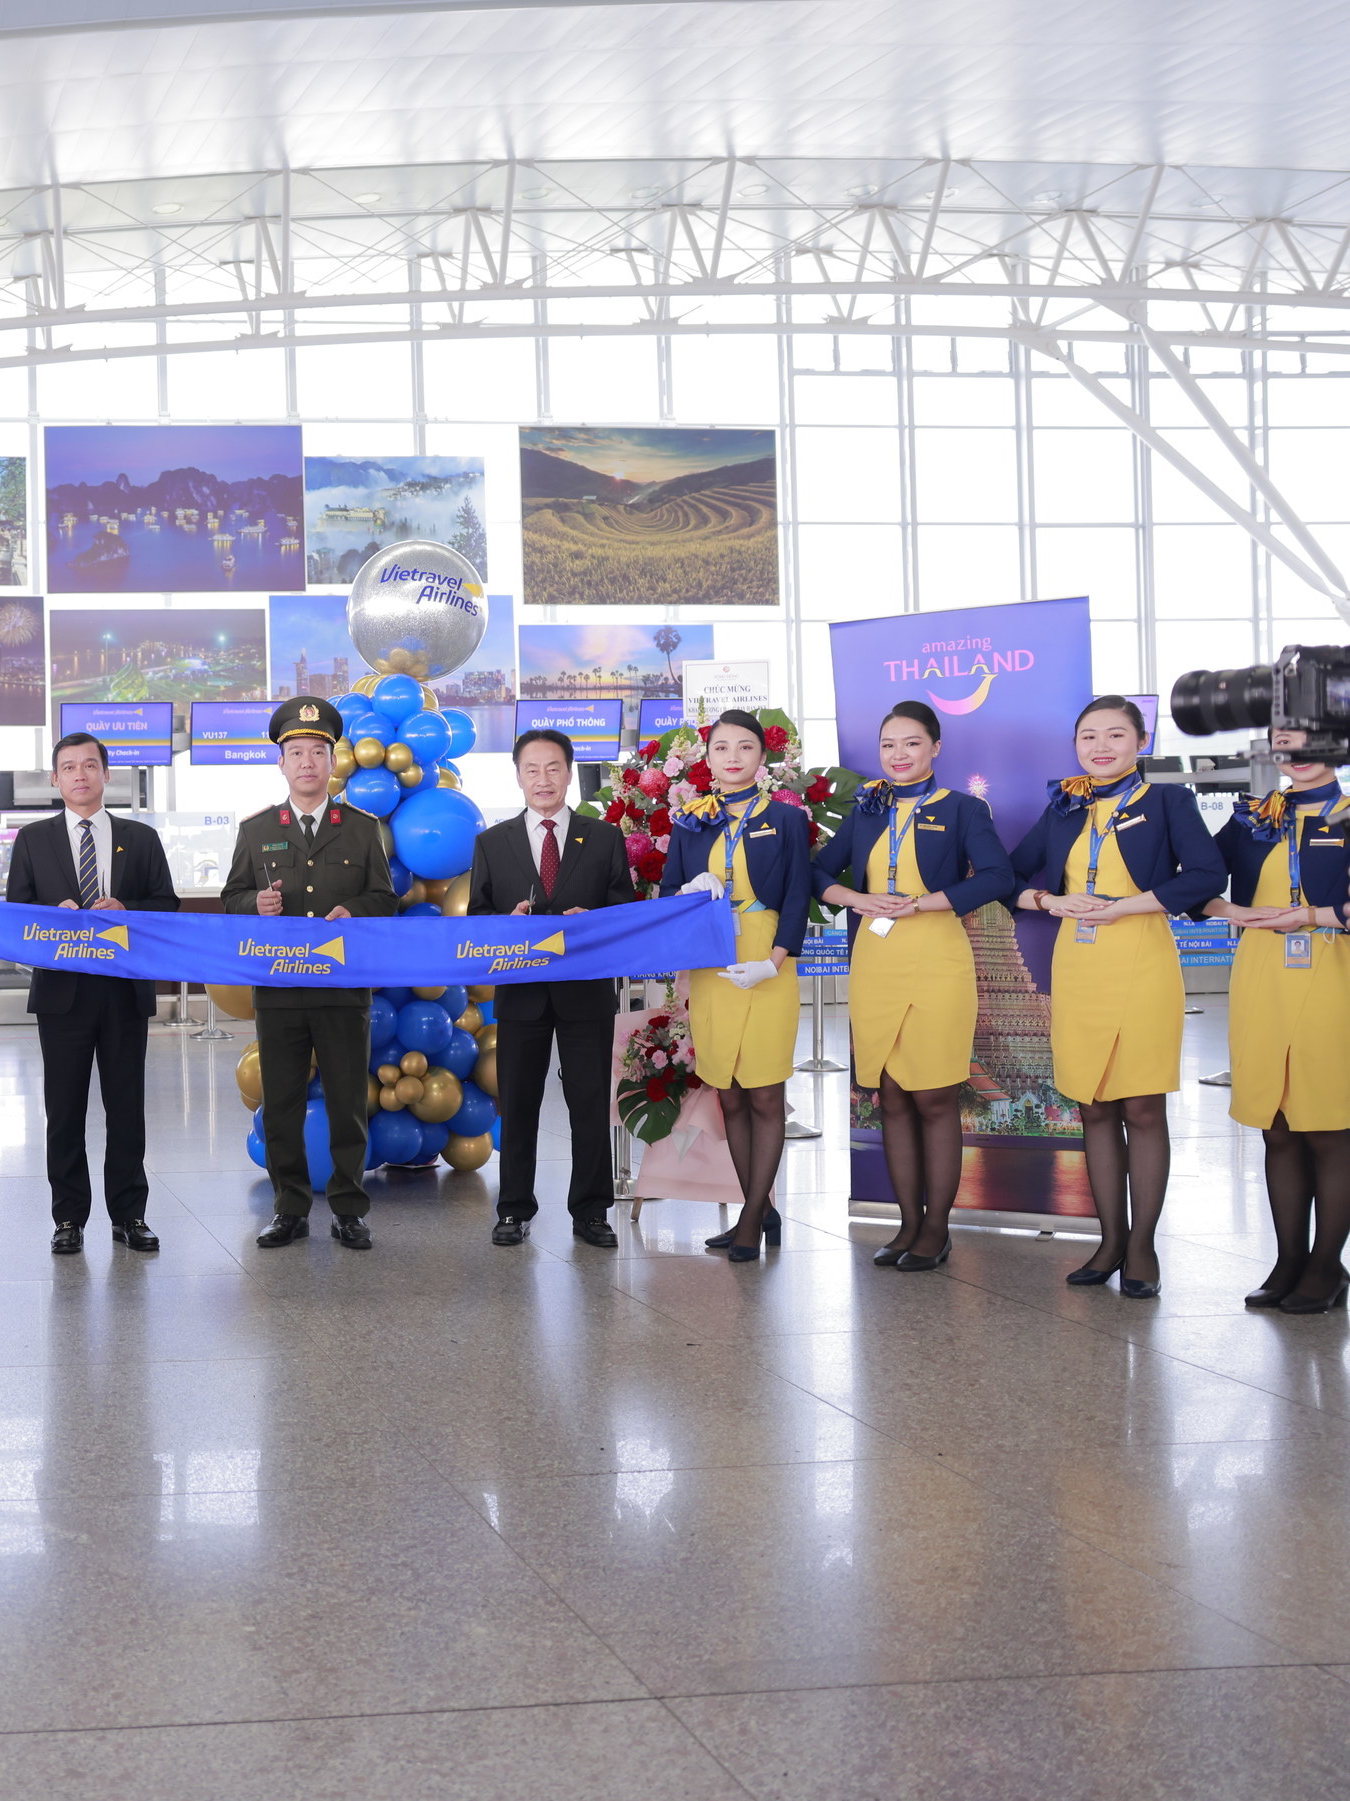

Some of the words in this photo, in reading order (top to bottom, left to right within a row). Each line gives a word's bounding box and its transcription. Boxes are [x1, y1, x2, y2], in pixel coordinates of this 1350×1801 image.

[380, 564, 463, 591] Vietravel
[416, 585, 479, 617] Airlines
[922, 635, 992, 654] amazing
[883, 649, 1035, 682] THAILAND
[86, 720, 111, 732] QUẦY
[112, 721, 126, 731] ƯU
[127, 720, 148, 731] TIÊN
[531, 717, 554, 728] QUẦY
[576, 717, 606, 727] THÔNG
[655, 715, 678, 728] QUẦY
[202, 731, 228, 739] VU137
[225, 750, 266, 761] Bangkok
[1201, 802, 1224, 811] B-08
[204, 816, 230, 826] B-03
[23, 923, 95, 941] Vietravel
[54, 942, 116, 960] Airlines
[238, 938, 310, 957] Vietravel
[456, 940, 529, 958] Vietravel
[270, 959, 331, 975] Airlines
[488, 957, 550, 974] Airlines
[805, 965, 830, 974] NOIBAI
